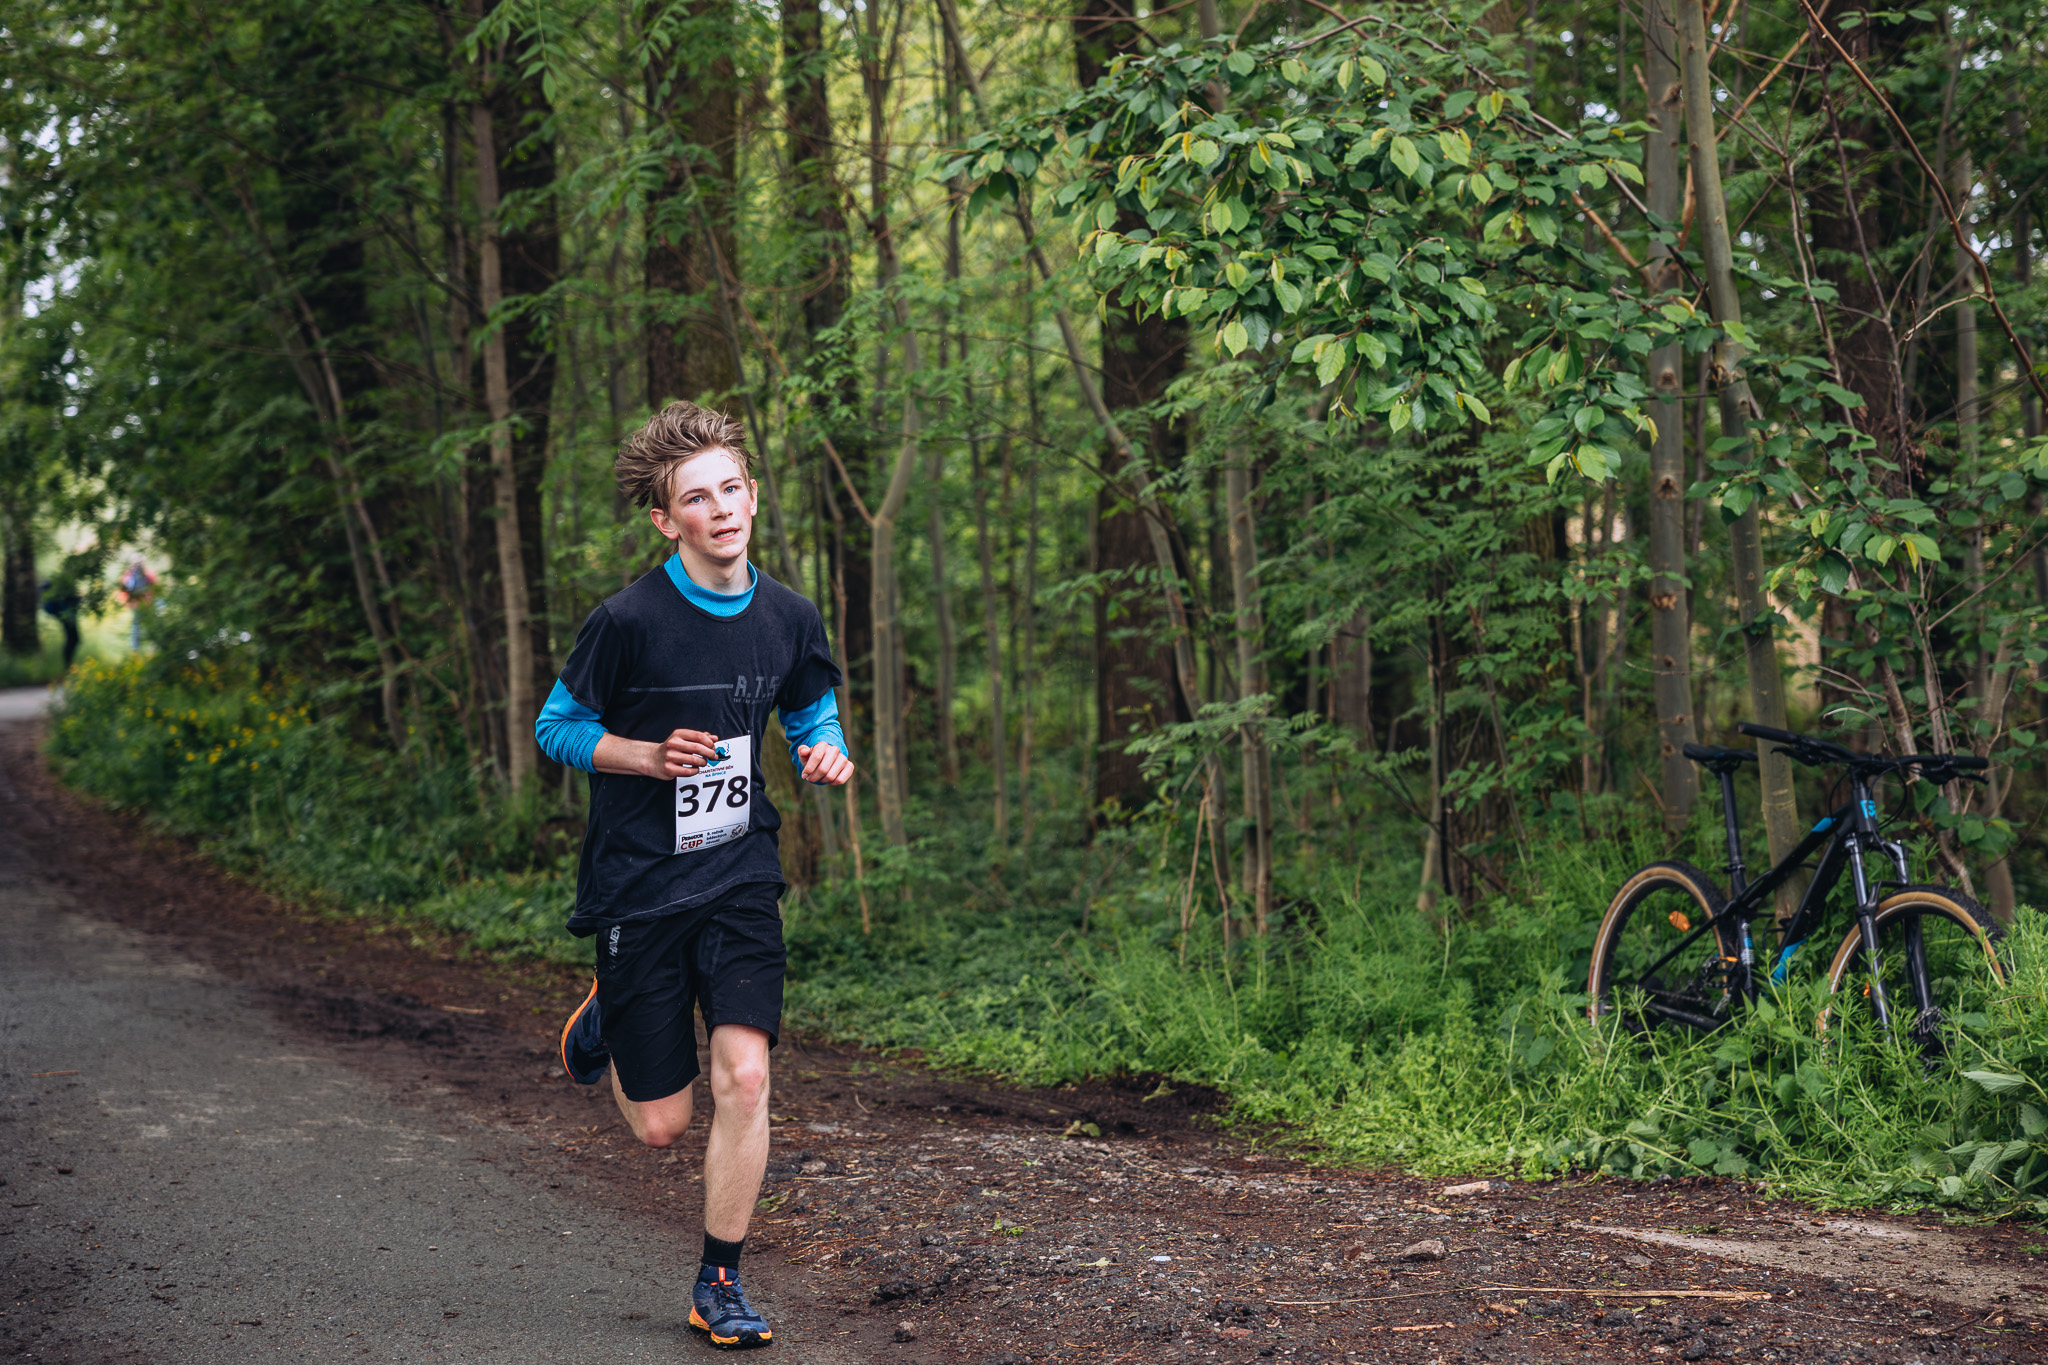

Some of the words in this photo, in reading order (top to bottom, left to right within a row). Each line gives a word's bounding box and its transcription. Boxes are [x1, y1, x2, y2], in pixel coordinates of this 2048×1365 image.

[678, 775, 749, 817] 378
[681, 839, 703, 850] CUP
[609, 924, 622, 957] HAVEN
